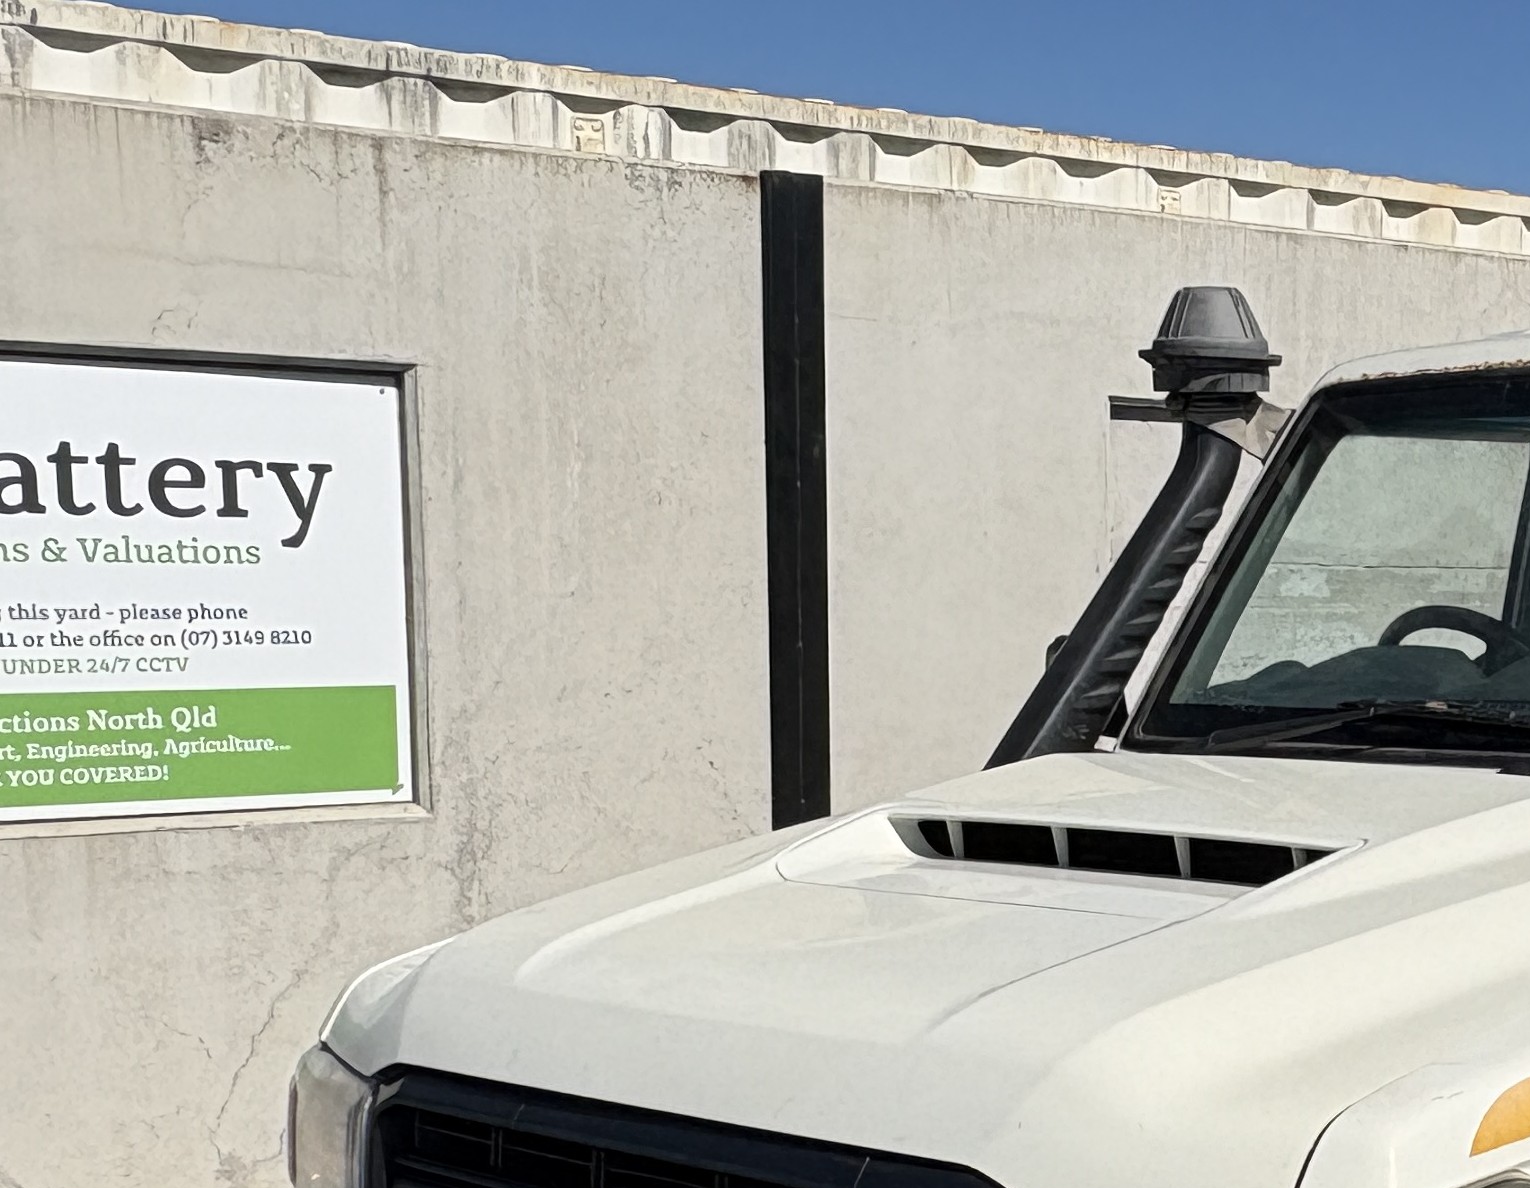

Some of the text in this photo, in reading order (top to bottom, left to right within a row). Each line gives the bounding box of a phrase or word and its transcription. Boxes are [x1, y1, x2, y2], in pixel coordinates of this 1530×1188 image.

[41, 537, 68, 563] &
[76, 535, 261, 565] Valuations
[8, 603, 50, 620] this
[54, 603, 101, 624] yard
[119, 603, 182, 624] please
[187, 602, 249, 624] phone
[23, 635, 45, 648] or
[50, 630, 84, 647] the
[89, 629, 145, 647] office
[150, 634, 177, 647] on
[180, 628, 219, 650] (07)
[222, 630, 265, 646] 3149
[270, 629, 313, 645] 8210
[2, 656, 190, 675] UNDER 24/7 CCTV
[86, 706, 165, 731] North
[170, 705, 218, 734] Qld
[5, 764, 170, 788] YOU COVERED!
